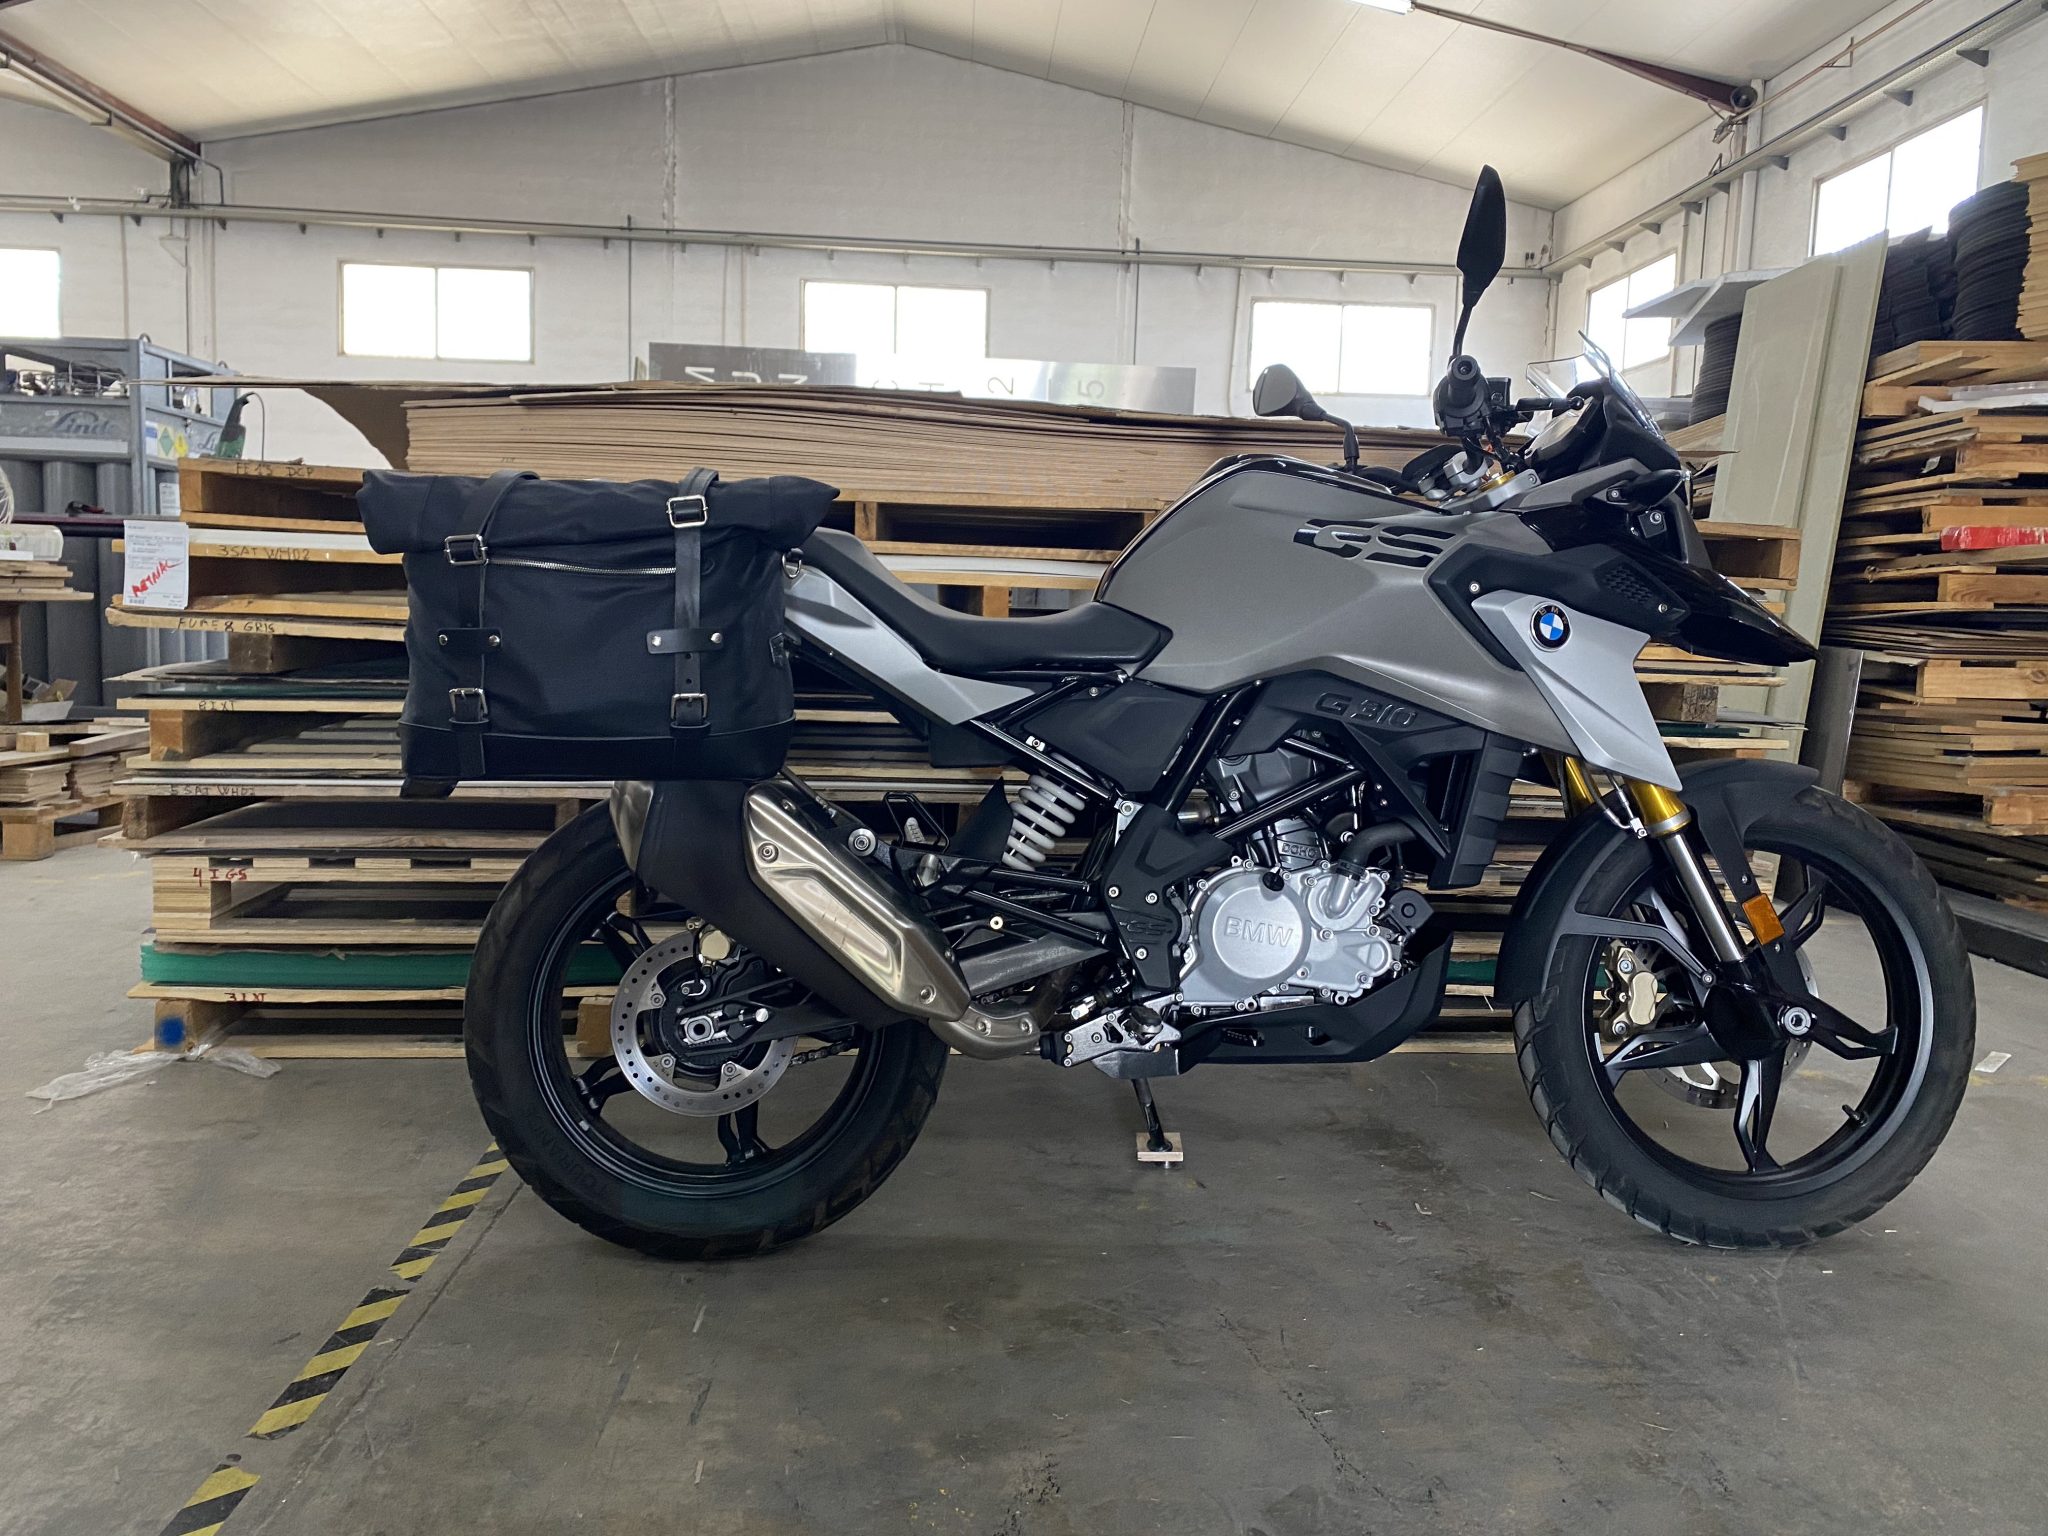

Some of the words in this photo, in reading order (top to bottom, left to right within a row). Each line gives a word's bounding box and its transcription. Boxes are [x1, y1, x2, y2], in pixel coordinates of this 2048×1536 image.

[1293, 518, 1457, 569] GS
[1315, 692, 1353, 716] G
[1223, 915, 1295, 948] BMW
